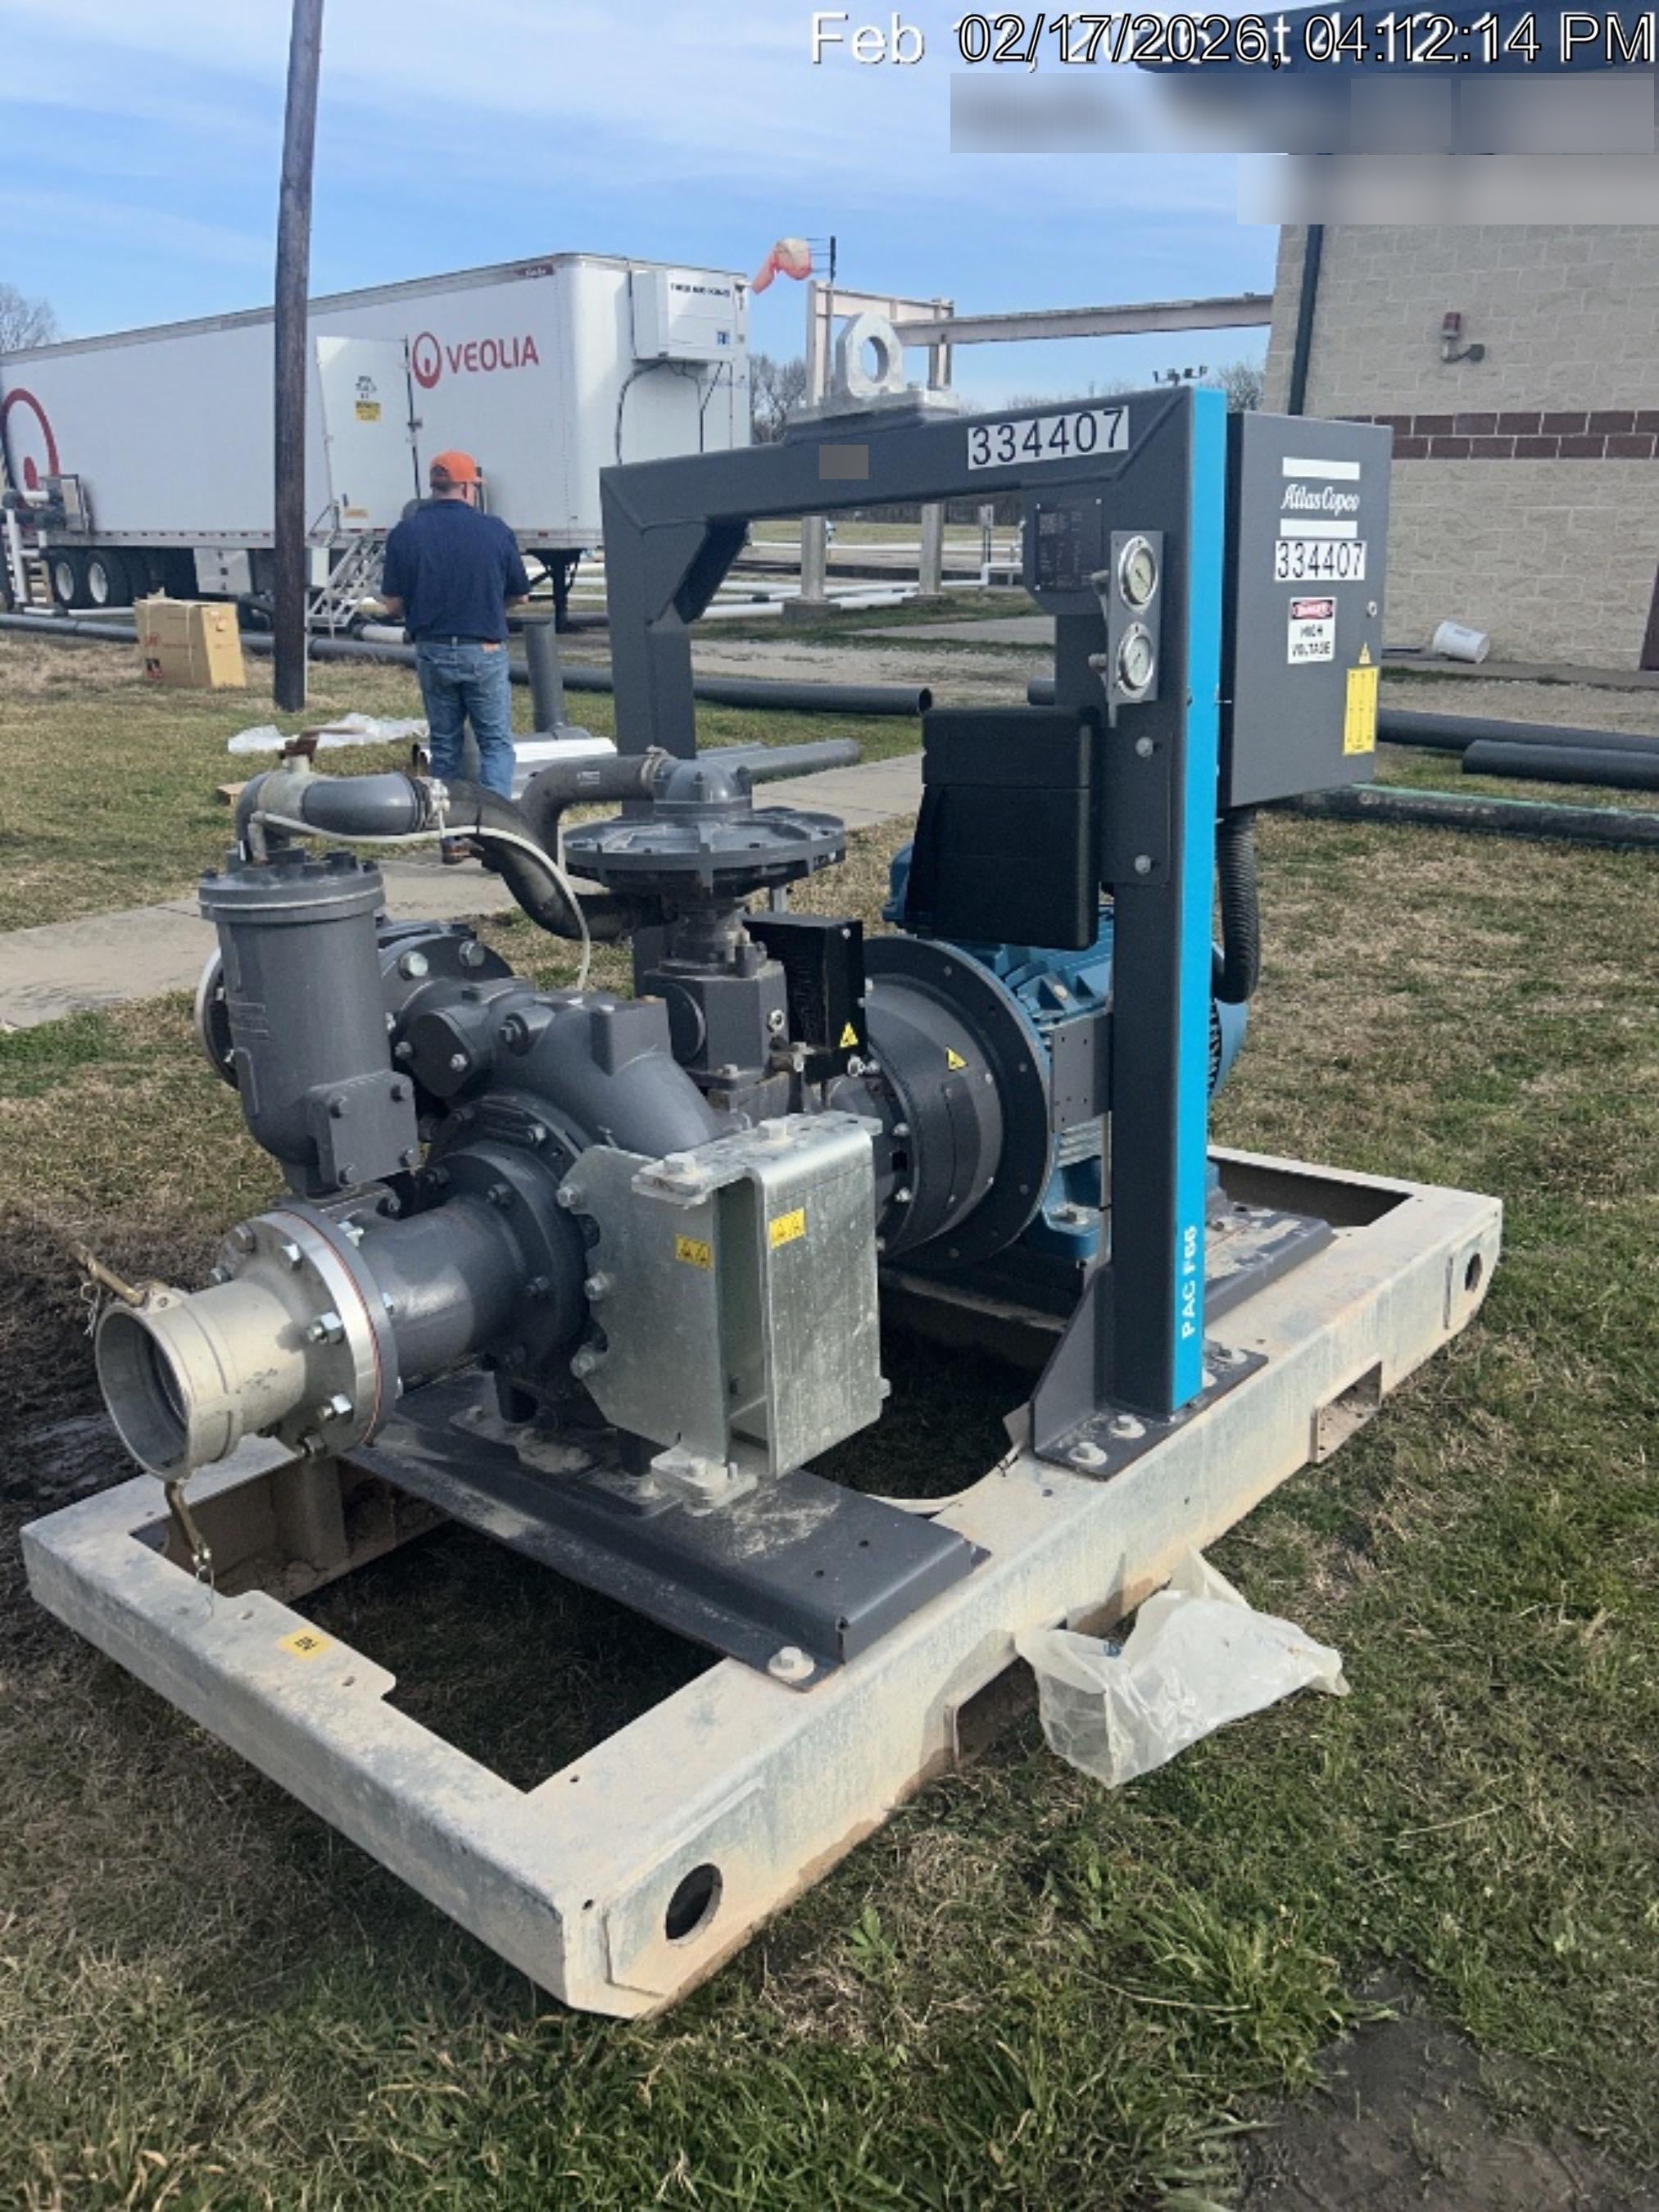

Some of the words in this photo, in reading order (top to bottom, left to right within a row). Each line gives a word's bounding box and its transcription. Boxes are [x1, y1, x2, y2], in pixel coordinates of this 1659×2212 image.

[446, 334, 539, 374] VEOLIA
[972, 410, 1124, 465] 334407
[1280, 483, 1321, 510] Atlas
[1278, 542, 1363, 578] 334407
[1181, 1280, 1196, 1340] PAC
